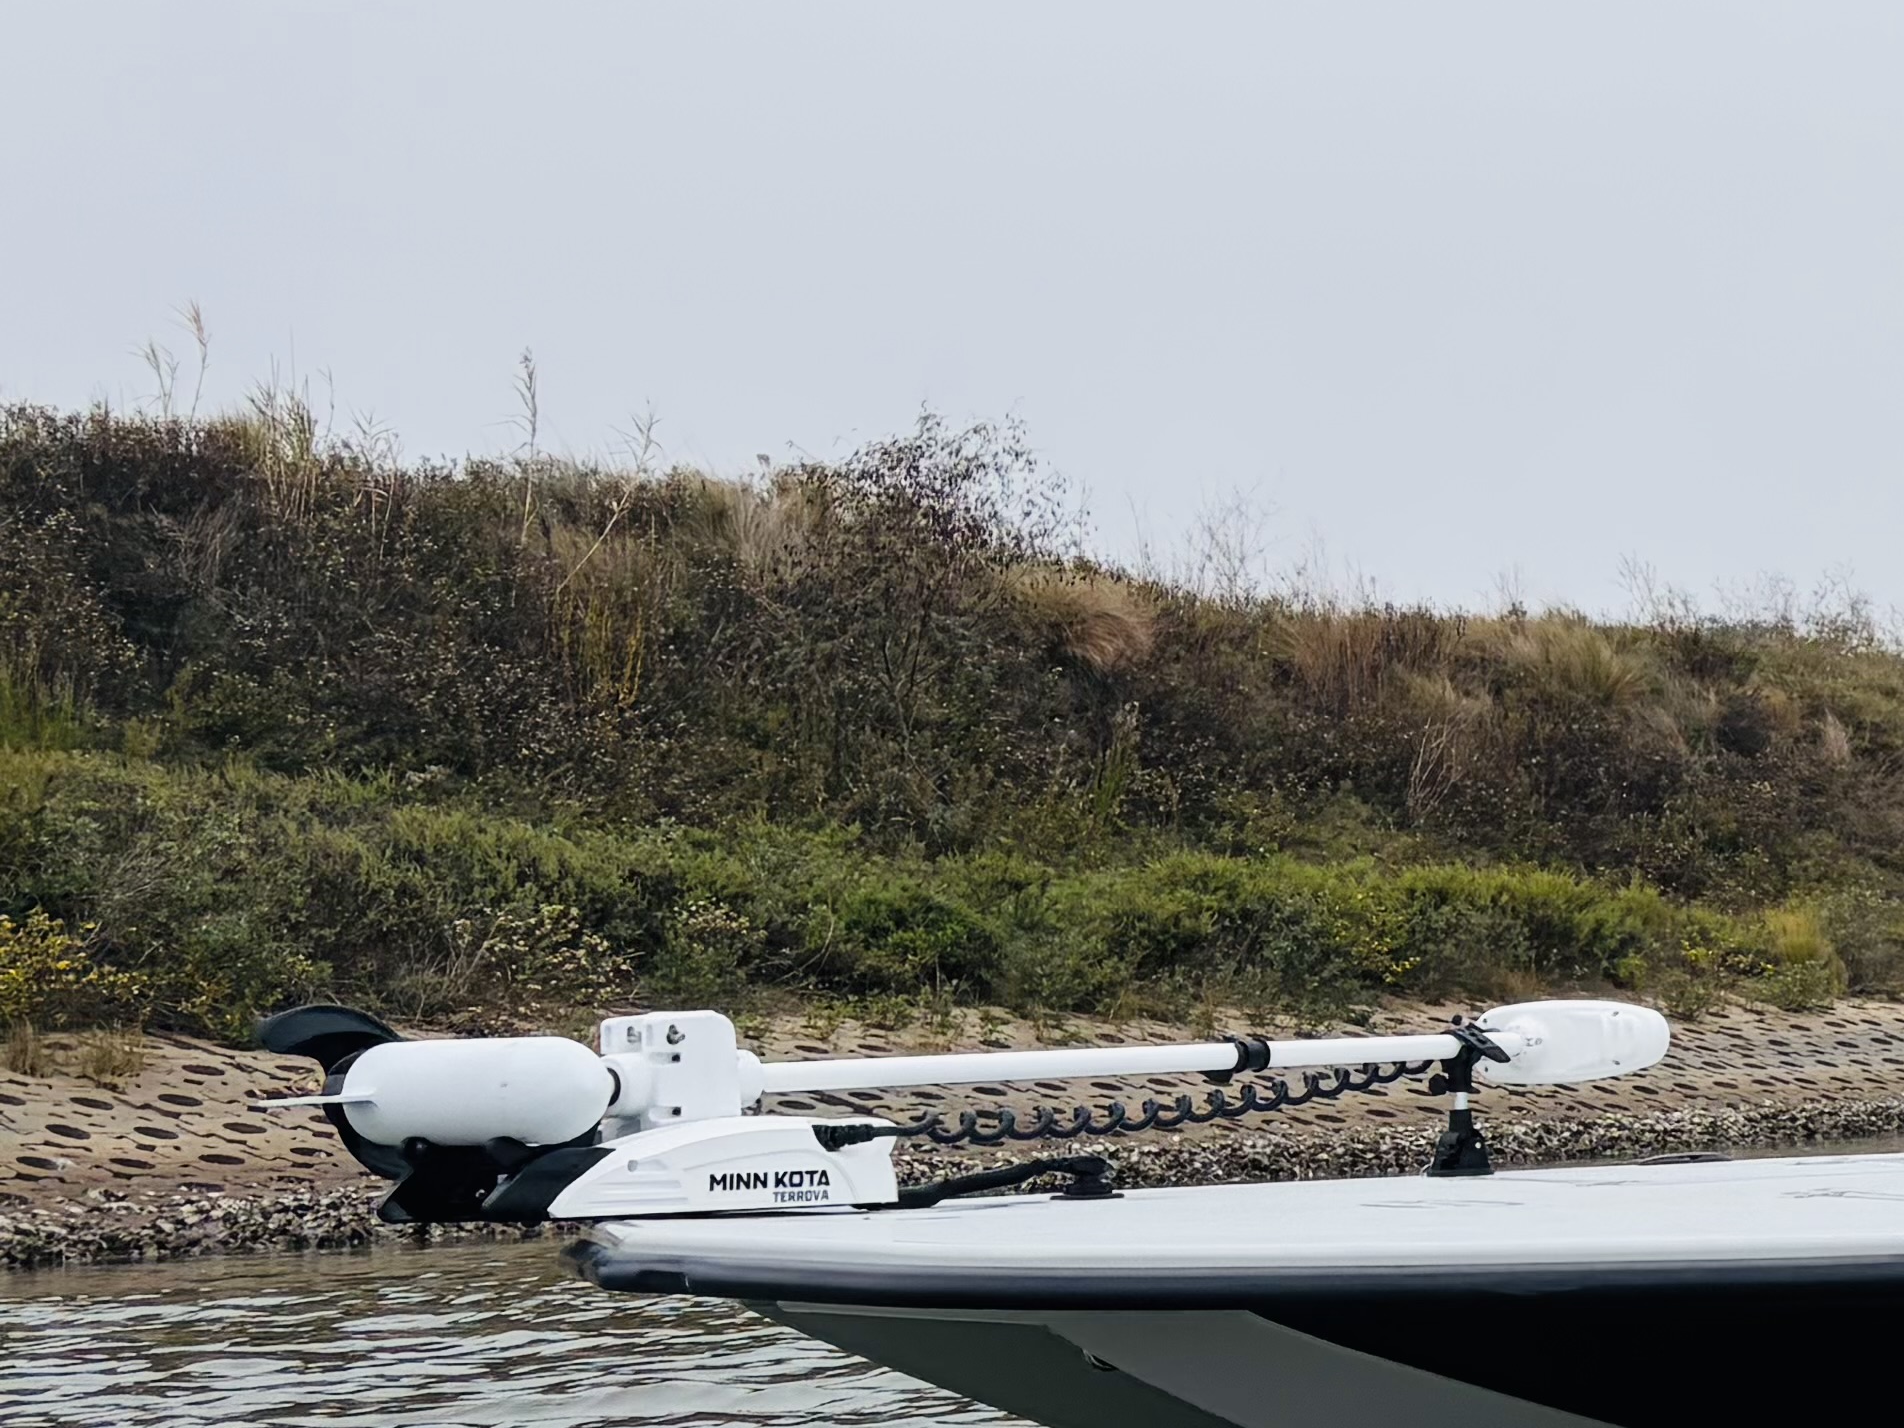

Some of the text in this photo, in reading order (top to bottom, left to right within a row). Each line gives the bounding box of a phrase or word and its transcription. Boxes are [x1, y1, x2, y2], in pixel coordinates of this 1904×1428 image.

[709, 1170, 831, 1192] MINN KOTA
[772, 1190, 830, 1203] TERROVA
